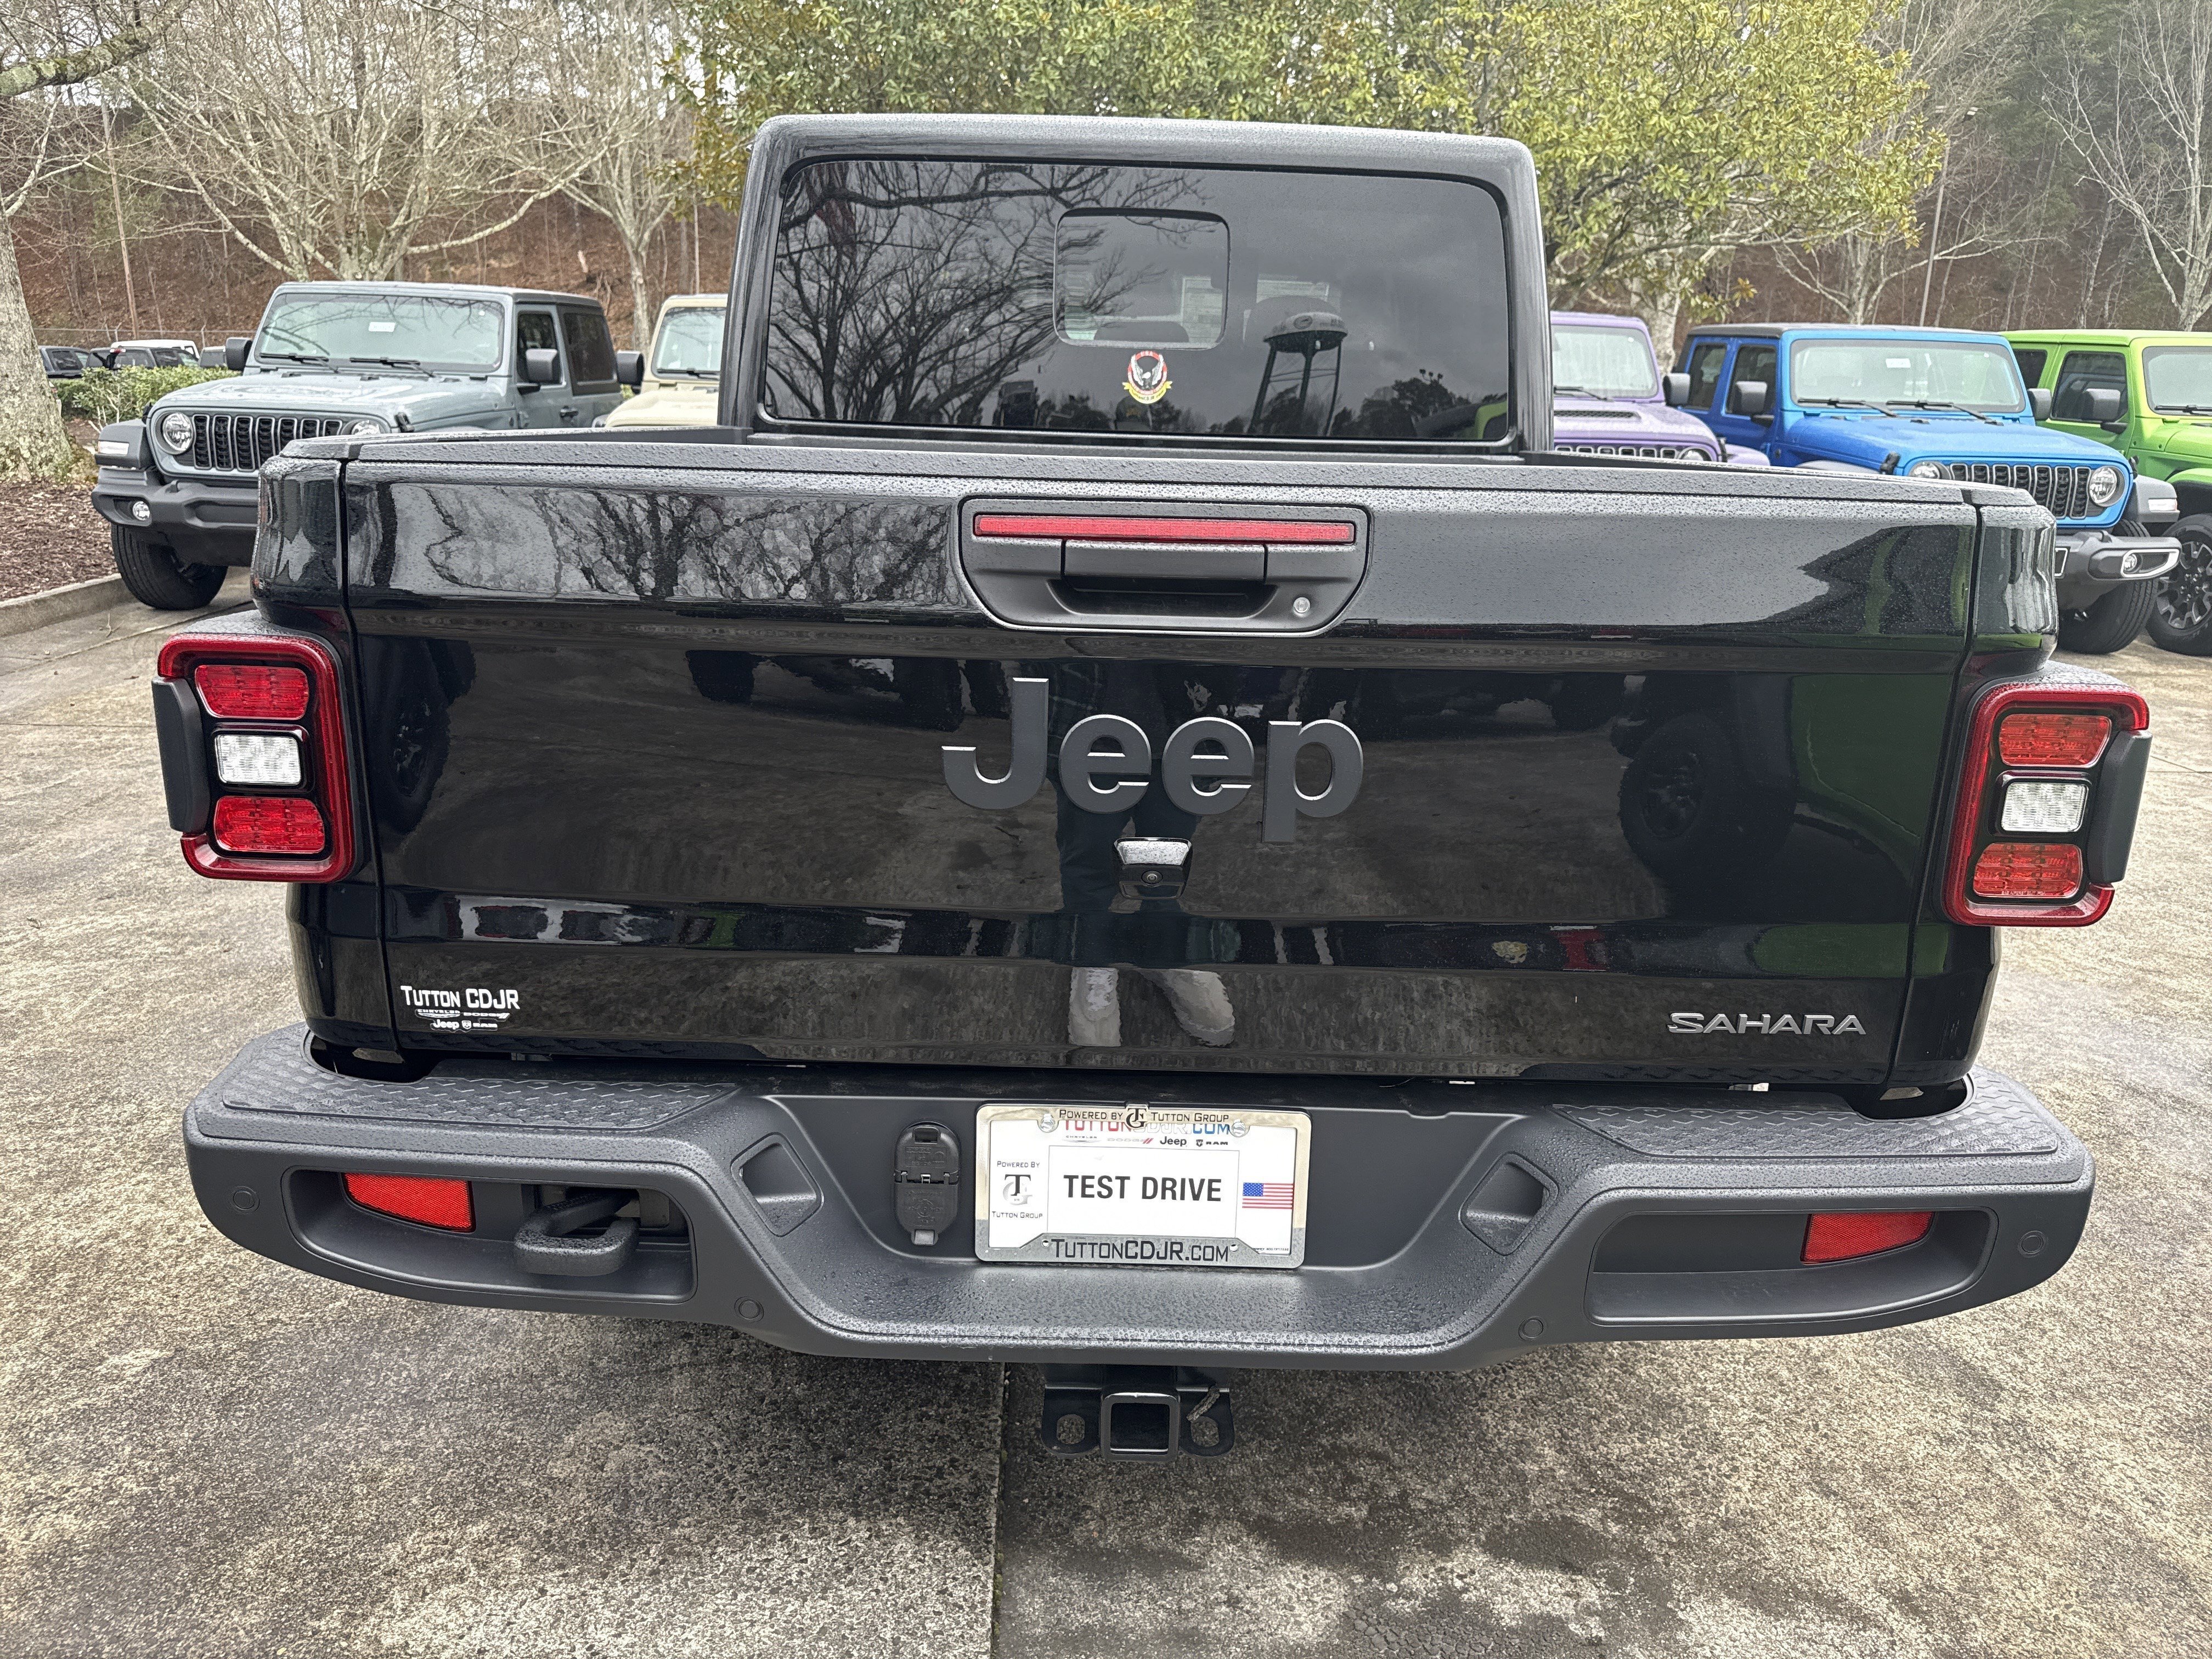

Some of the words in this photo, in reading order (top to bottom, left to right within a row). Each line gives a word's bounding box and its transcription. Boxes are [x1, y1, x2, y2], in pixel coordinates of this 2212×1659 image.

[941, 678, 1363, 843] Jeep
[466, 989, 520, 1009] CDJR
[433, 1019, 460, 1030] Jeep
[1667, 1012, 1866, 1035] SAHARA
[1160, 1136, 1187, 1147] Jeep
[1063, 1175, 1130, 1199] TEST
[1142, 1176, 1221, 1201] DRIVE
